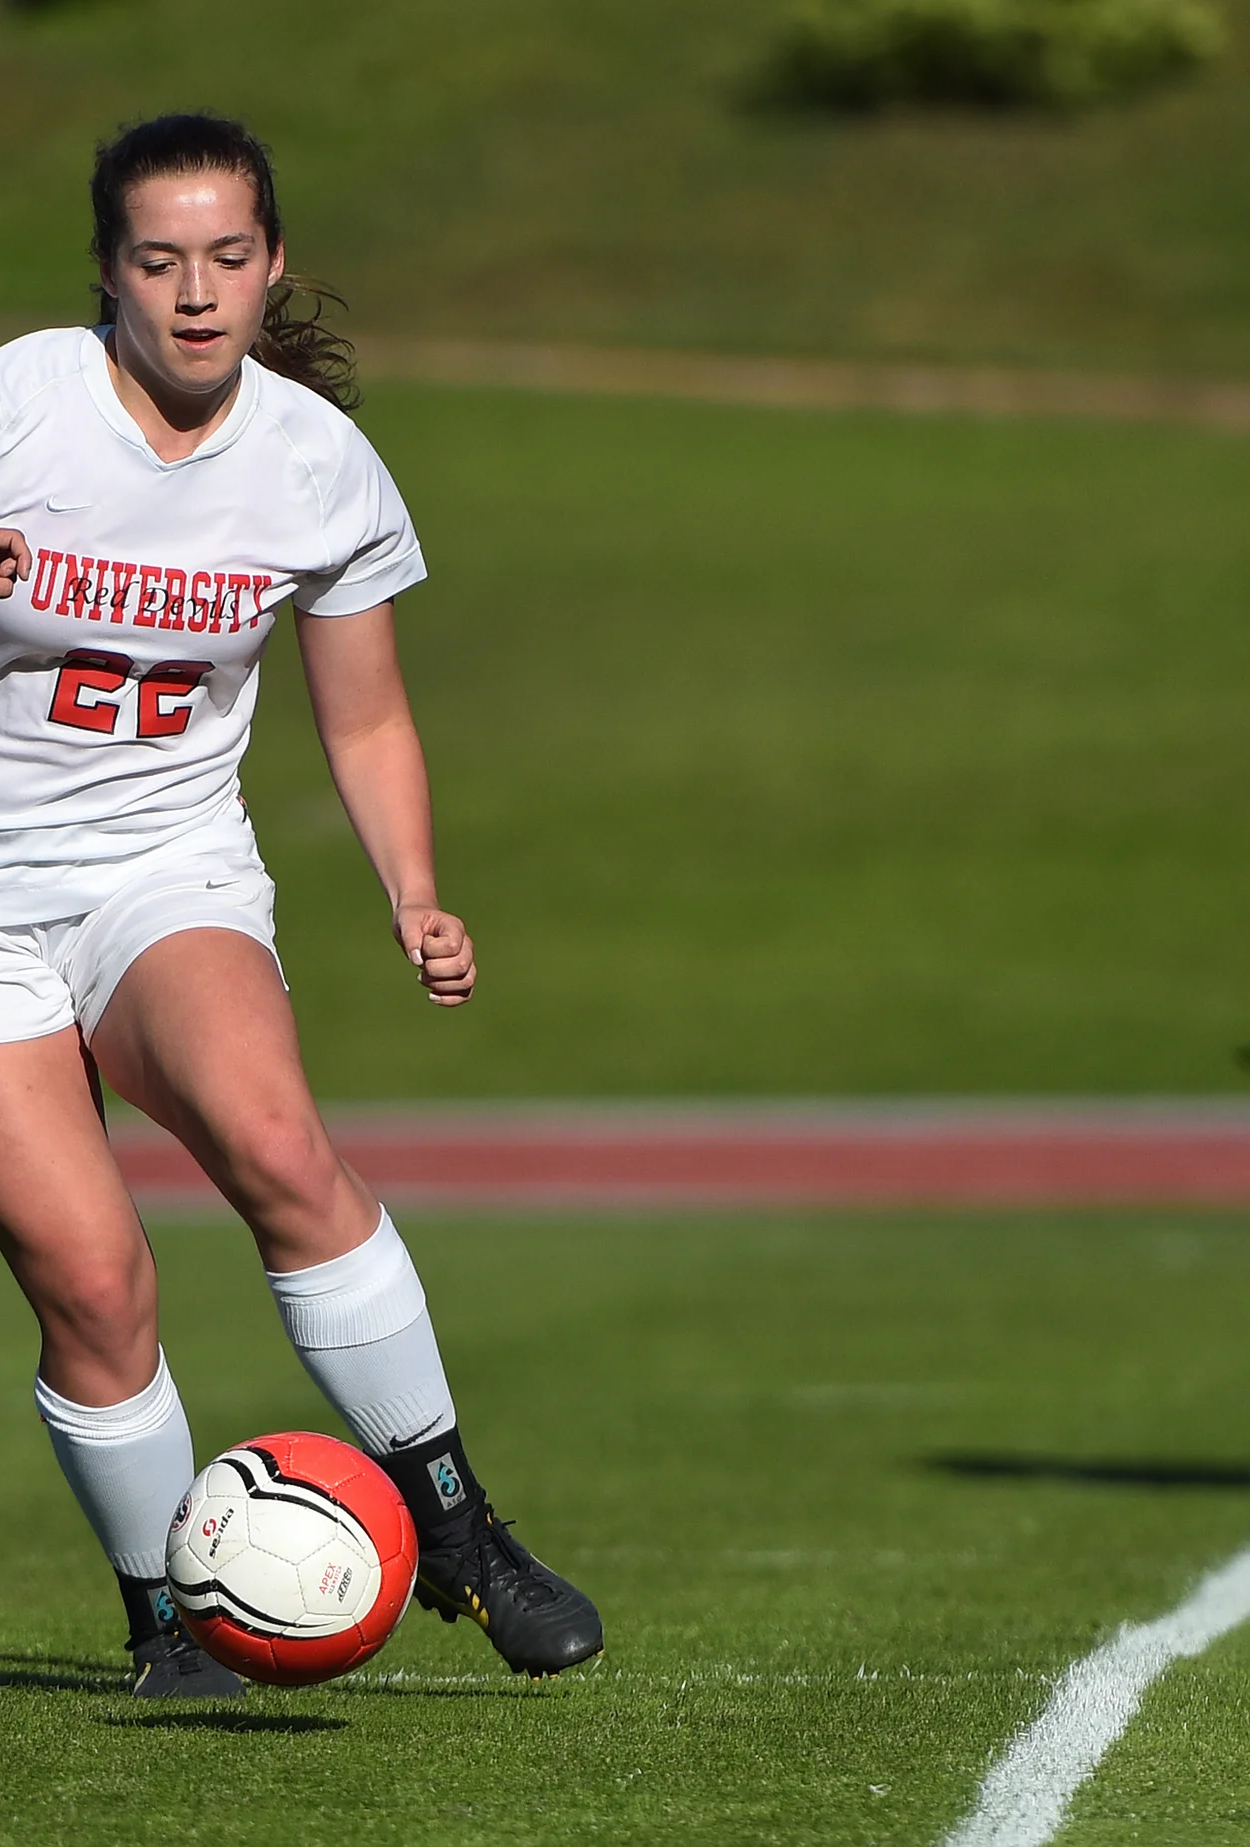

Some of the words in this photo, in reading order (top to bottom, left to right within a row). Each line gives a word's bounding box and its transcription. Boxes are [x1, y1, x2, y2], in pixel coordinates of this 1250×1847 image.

[30, 547, 272, 634] UNIVERSITY
[67, 576, 140, 609] Red
[141, 586, 241, 620] Devils
[47, 647, 216, 739] 22
[209, 1508, 234, 1559] senda
[318, 1561, 337, 1595] APEX
